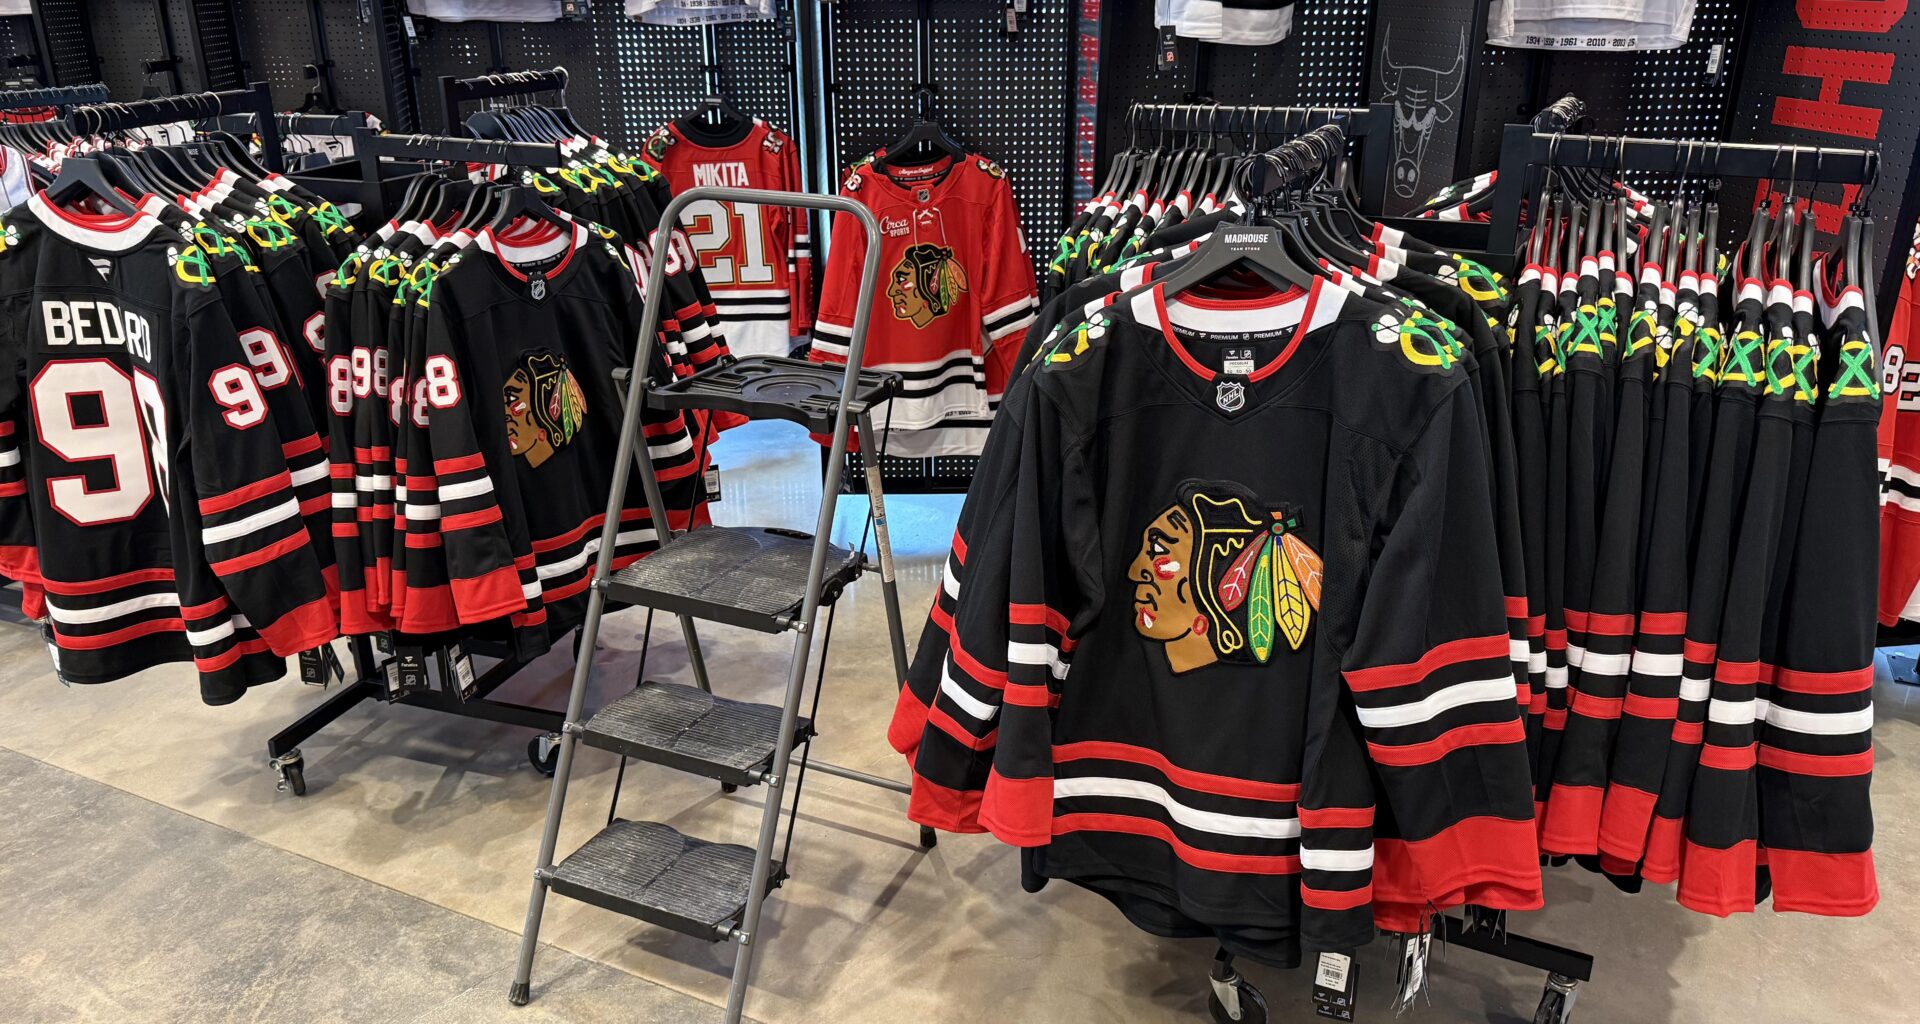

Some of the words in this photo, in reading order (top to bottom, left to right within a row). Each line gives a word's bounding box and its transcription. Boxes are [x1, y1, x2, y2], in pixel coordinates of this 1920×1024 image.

[1525, 35, 1540, 45] 1934
[1560, 37, 1578, 46] 1961
[1586, 38, 1606, 47] 2010
[692, 162, 750, 187] MIKITA
[679, 199, 775, 286] 21
[880, 216, 908, 234] Circa
[890, 227, 910, 237] SPORTS
[1224, 233, 1269, 243] MADHOUSE
[42, 301, 152, 363] BEDRD
[1253, 330, 1282, 339] PREMIUM
[237, 326, 293, 391] 9
[426, 354, 462, 409] 8
[1882, 345, 1905, 394] 8
[208, 363, 269, 430] 9
[327, 354, 353, 416] 8
